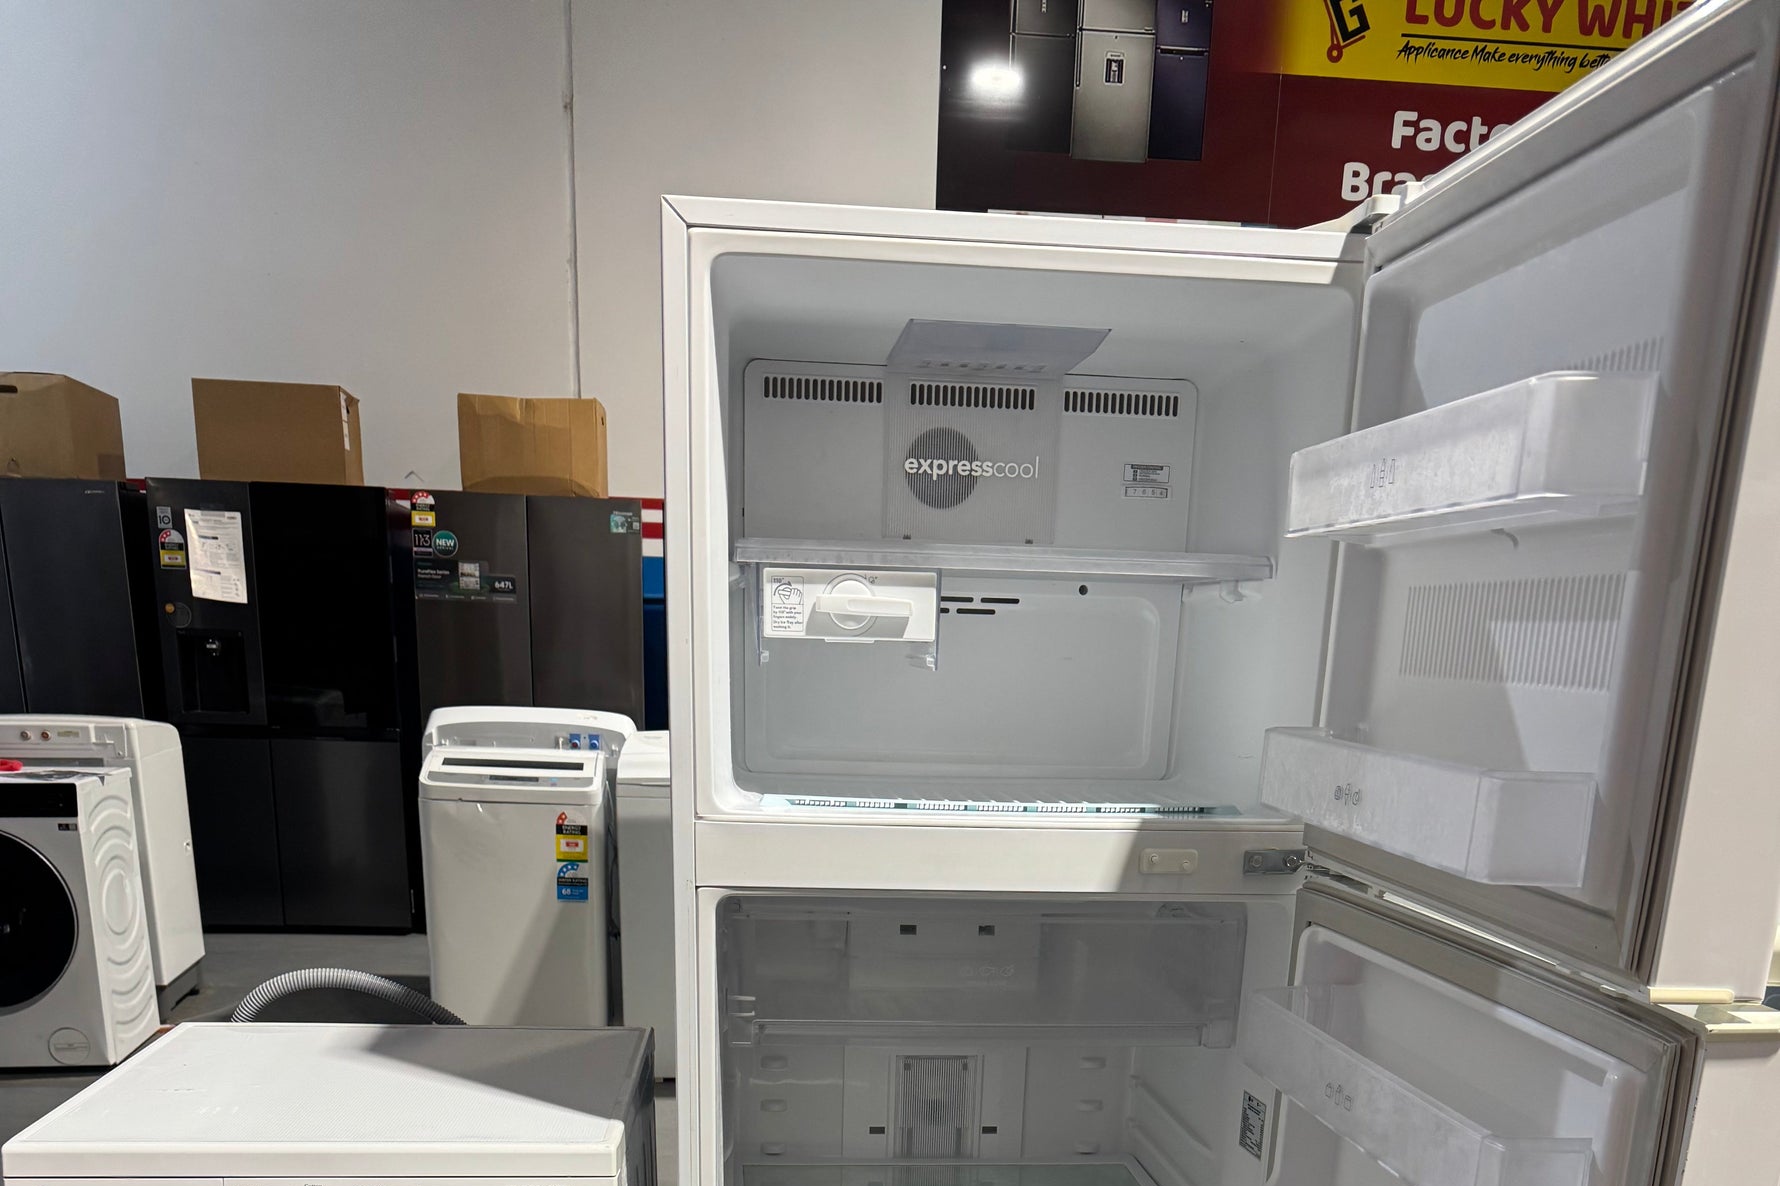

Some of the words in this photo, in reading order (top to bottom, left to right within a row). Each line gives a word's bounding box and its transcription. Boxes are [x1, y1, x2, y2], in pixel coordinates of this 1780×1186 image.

[1405, 0, 1565, 34] LUCKY
[1397, 40, 1469, 64] Applicance
[1470, 45, 1504, 66] Make
[1508, 50, 1577, 73] everything
[904, 456, 1039, 480] expresscool
[436, 538, 455, 547] NEW
